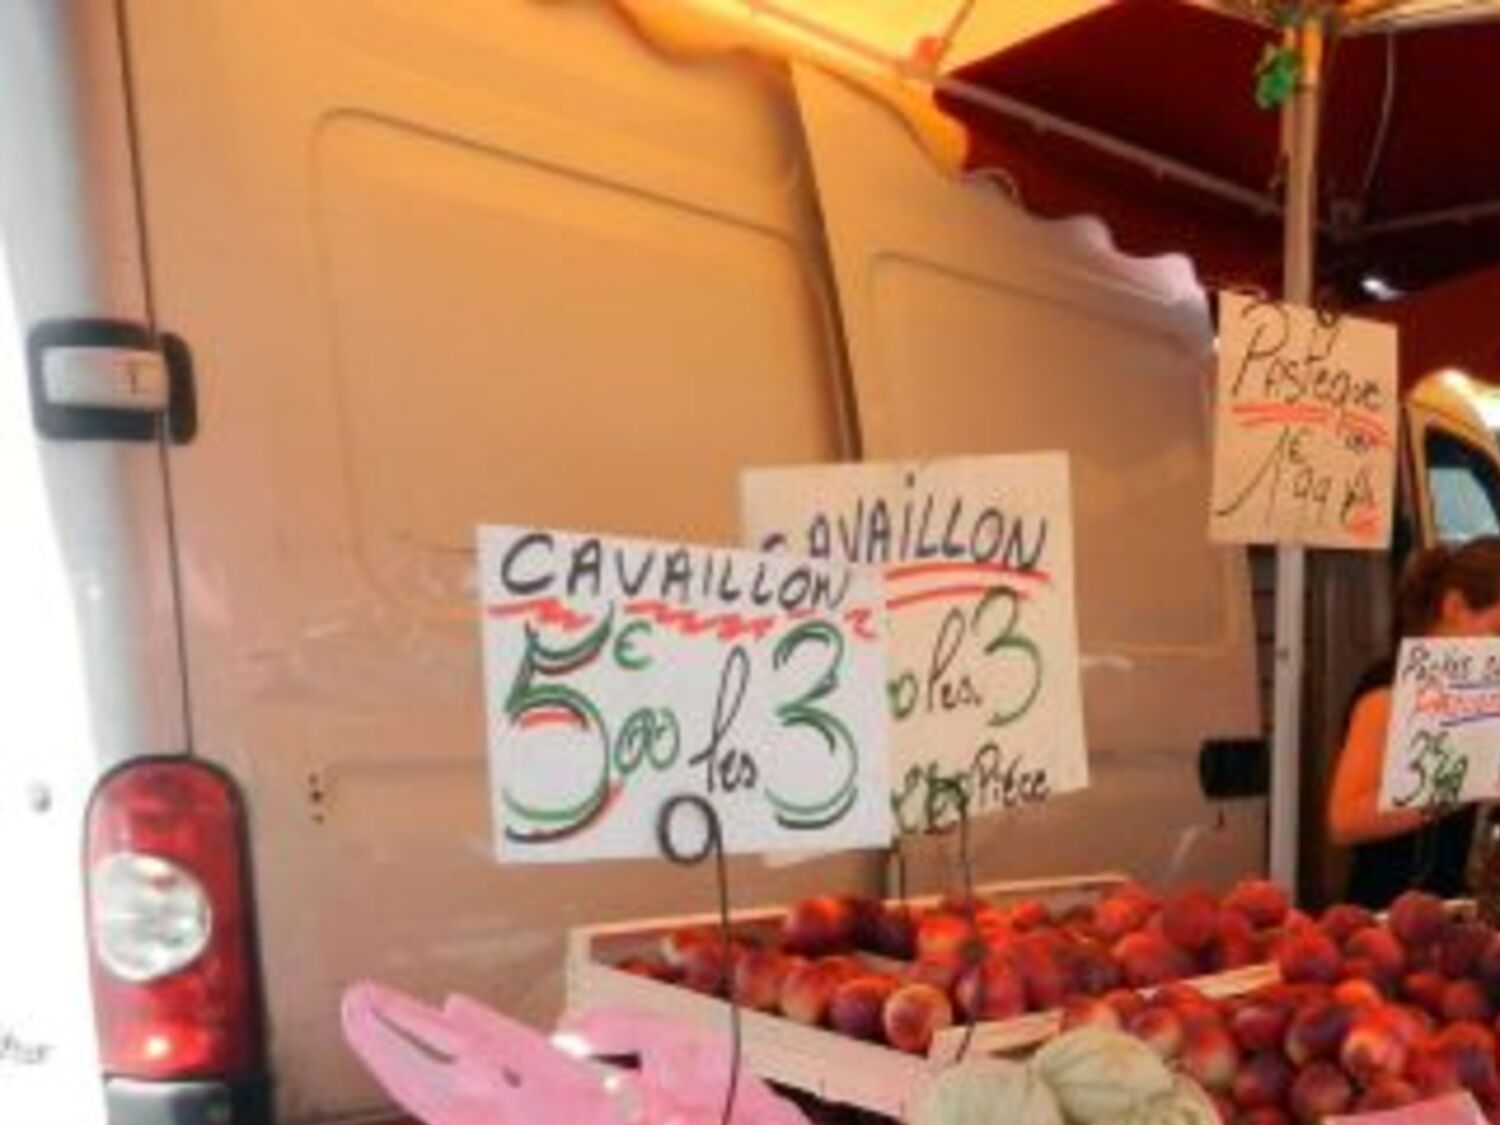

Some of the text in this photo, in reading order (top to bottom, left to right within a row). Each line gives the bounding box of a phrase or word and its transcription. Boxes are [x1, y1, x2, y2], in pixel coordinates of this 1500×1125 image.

[500, 533, 851, 611] CAVAILLON
[689, 645, 757, 794] les
[763, 619, 859, 830] 3
[971, 585, 1043, 728] 3
